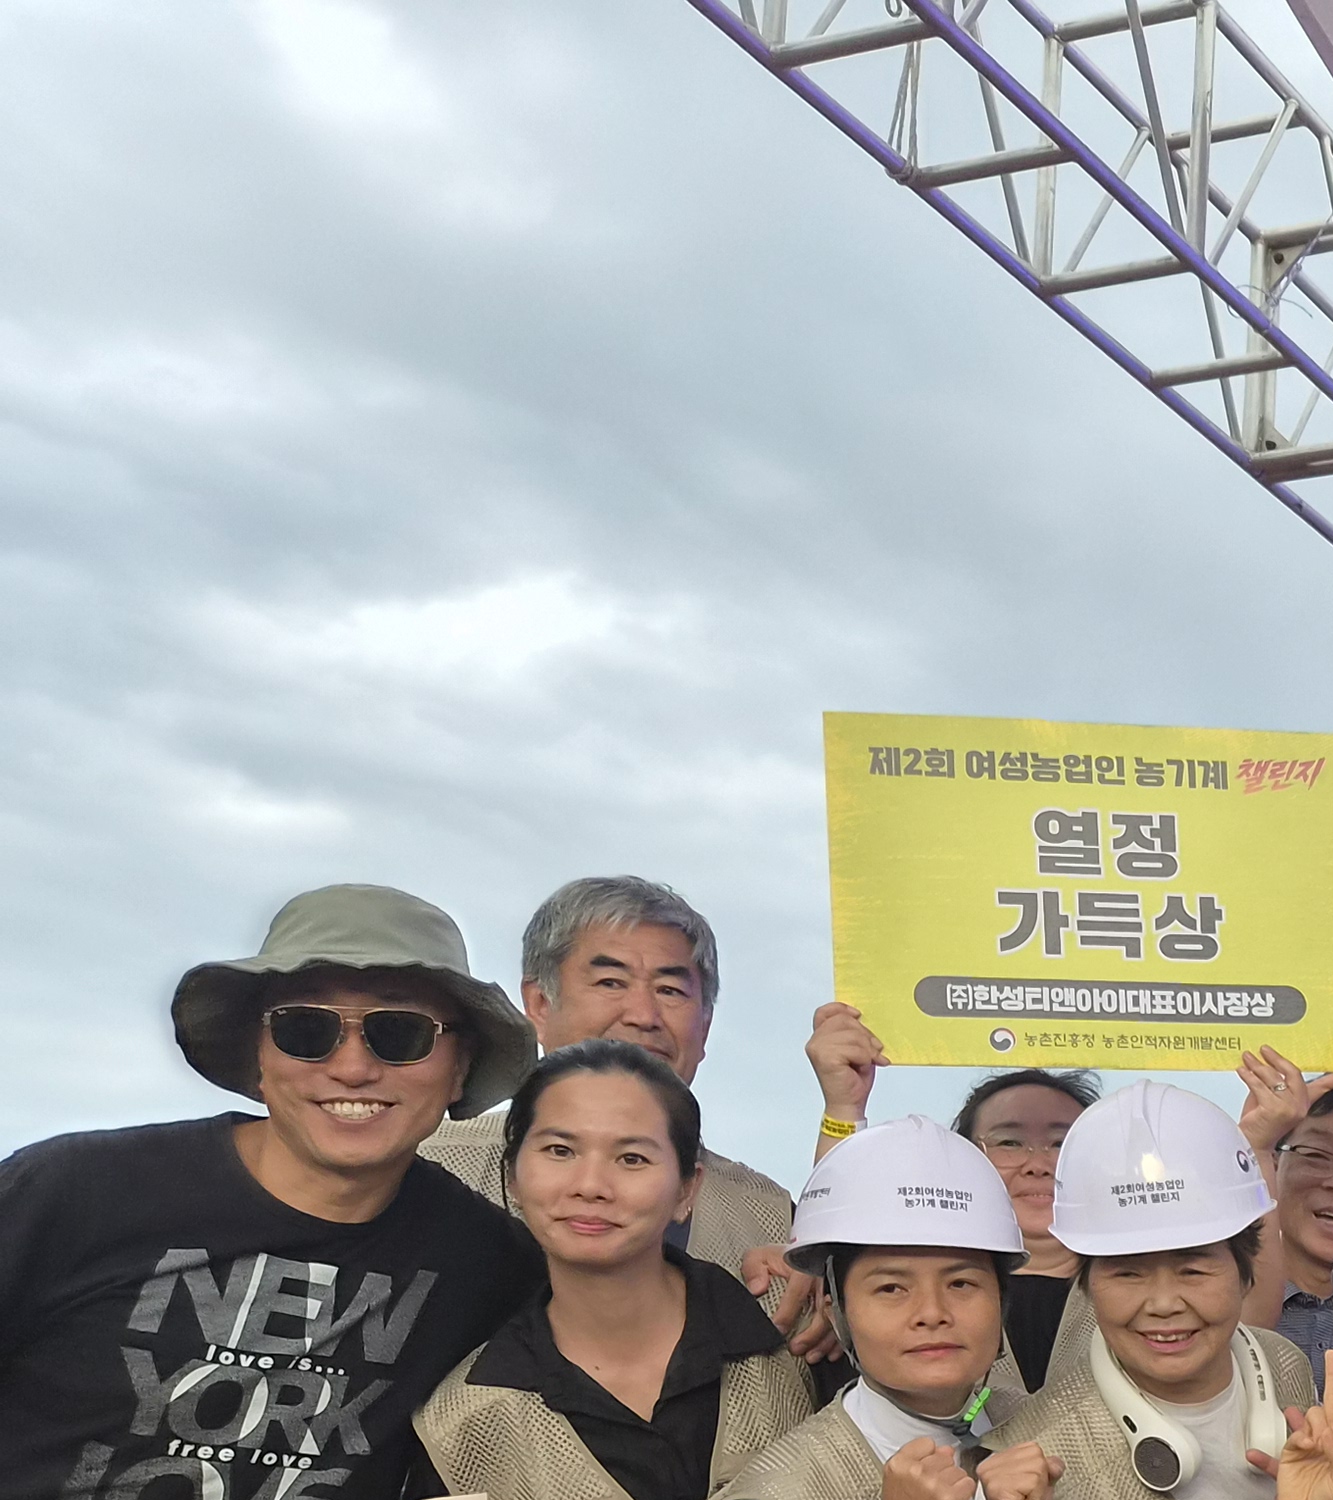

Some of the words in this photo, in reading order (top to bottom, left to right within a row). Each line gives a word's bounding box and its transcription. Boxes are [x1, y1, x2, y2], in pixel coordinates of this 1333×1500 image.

[869, 746, 955, 779] 제2회
[966, 751, 1125, 787] 여성농업인
[1134, 756, 1229, 791] 농기계
[1236, 757, 1328, 795] 챌린지
[1033, 808, 1179, 879] 열정
[996, 890, 1224, 961] 가득상
[1023, 1031, 1096, 1051] 농촌진흥청
[1101, 1033, 1243, 1052] 농촌인적자원개발센터
[904, 1198, 937, 1209] 농기계
[939, 1199, 969, 1213] 챌린지
[1117, 1194, 1148, 1208] 농기계
[1150, 1191, 1181, 1204] 챌린지
[127, 1247, 439, 1364] NEW
[205, 1343, 276, 1371] love
[120, 1345, 395, 1456] YORK
[167, 1438, 236, 1464] free
[249, 1448, 315, 1472] love
